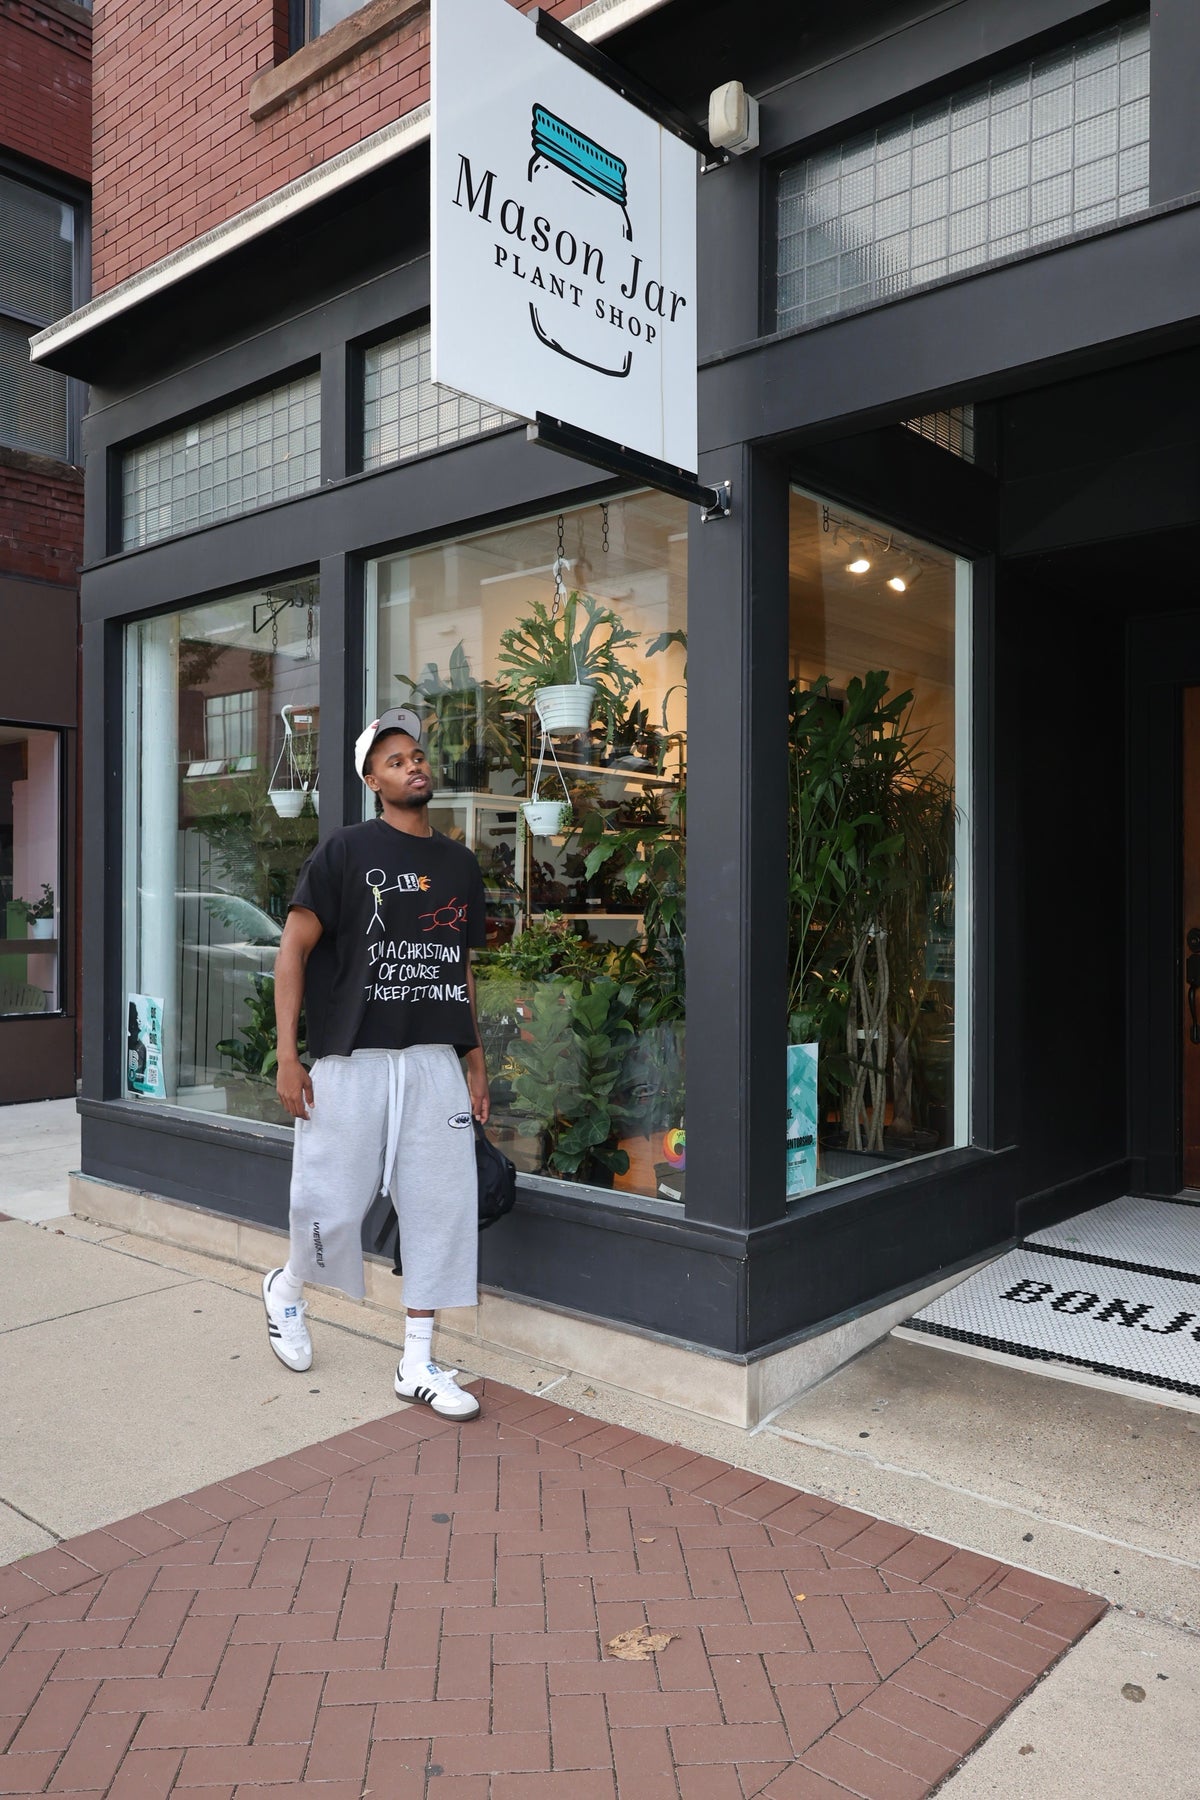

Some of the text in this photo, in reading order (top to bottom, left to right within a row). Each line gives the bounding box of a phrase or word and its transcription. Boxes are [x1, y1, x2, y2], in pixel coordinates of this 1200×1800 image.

[452, 153, 686, 323] Mason Jar
[494, 243, 656, 344] PLANT SHOP
[386, 941, 396, 958] A
[397, 940, 460, 963] CHRISTIAN
[378, 962, 440, 982] OF COURSE
[374, 983, 411, 1002] KEEP
[410, 985, 430, 1002] IT
[428, 984, 443, 1001] ON
[445, 983, 470, 1004] ME.
[787, 1135, 814, 1149] ENTORSHIP.
[1000, 1279, 1200, 1342] BONJ
